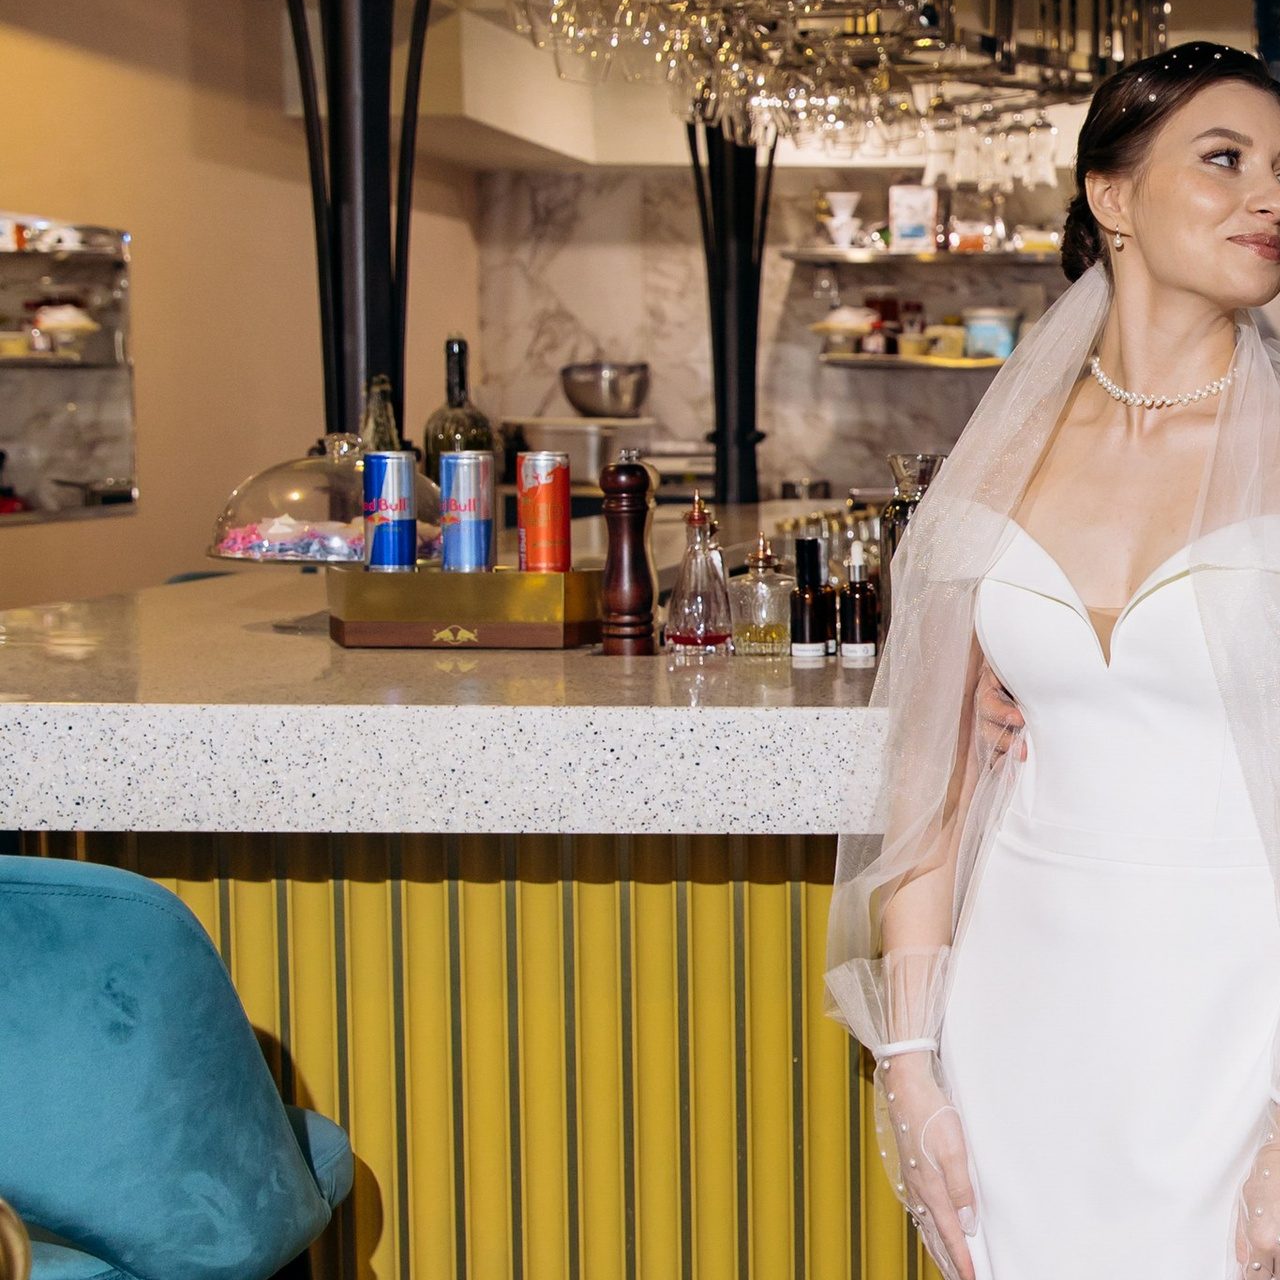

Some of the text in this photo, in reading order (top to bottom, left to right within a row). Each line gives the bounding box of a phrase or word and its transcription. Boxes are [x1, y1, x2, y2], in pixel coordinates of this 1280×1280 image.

[362, 498, 406, 511] ed Bull
[448, 498, 477, 512] Bull
